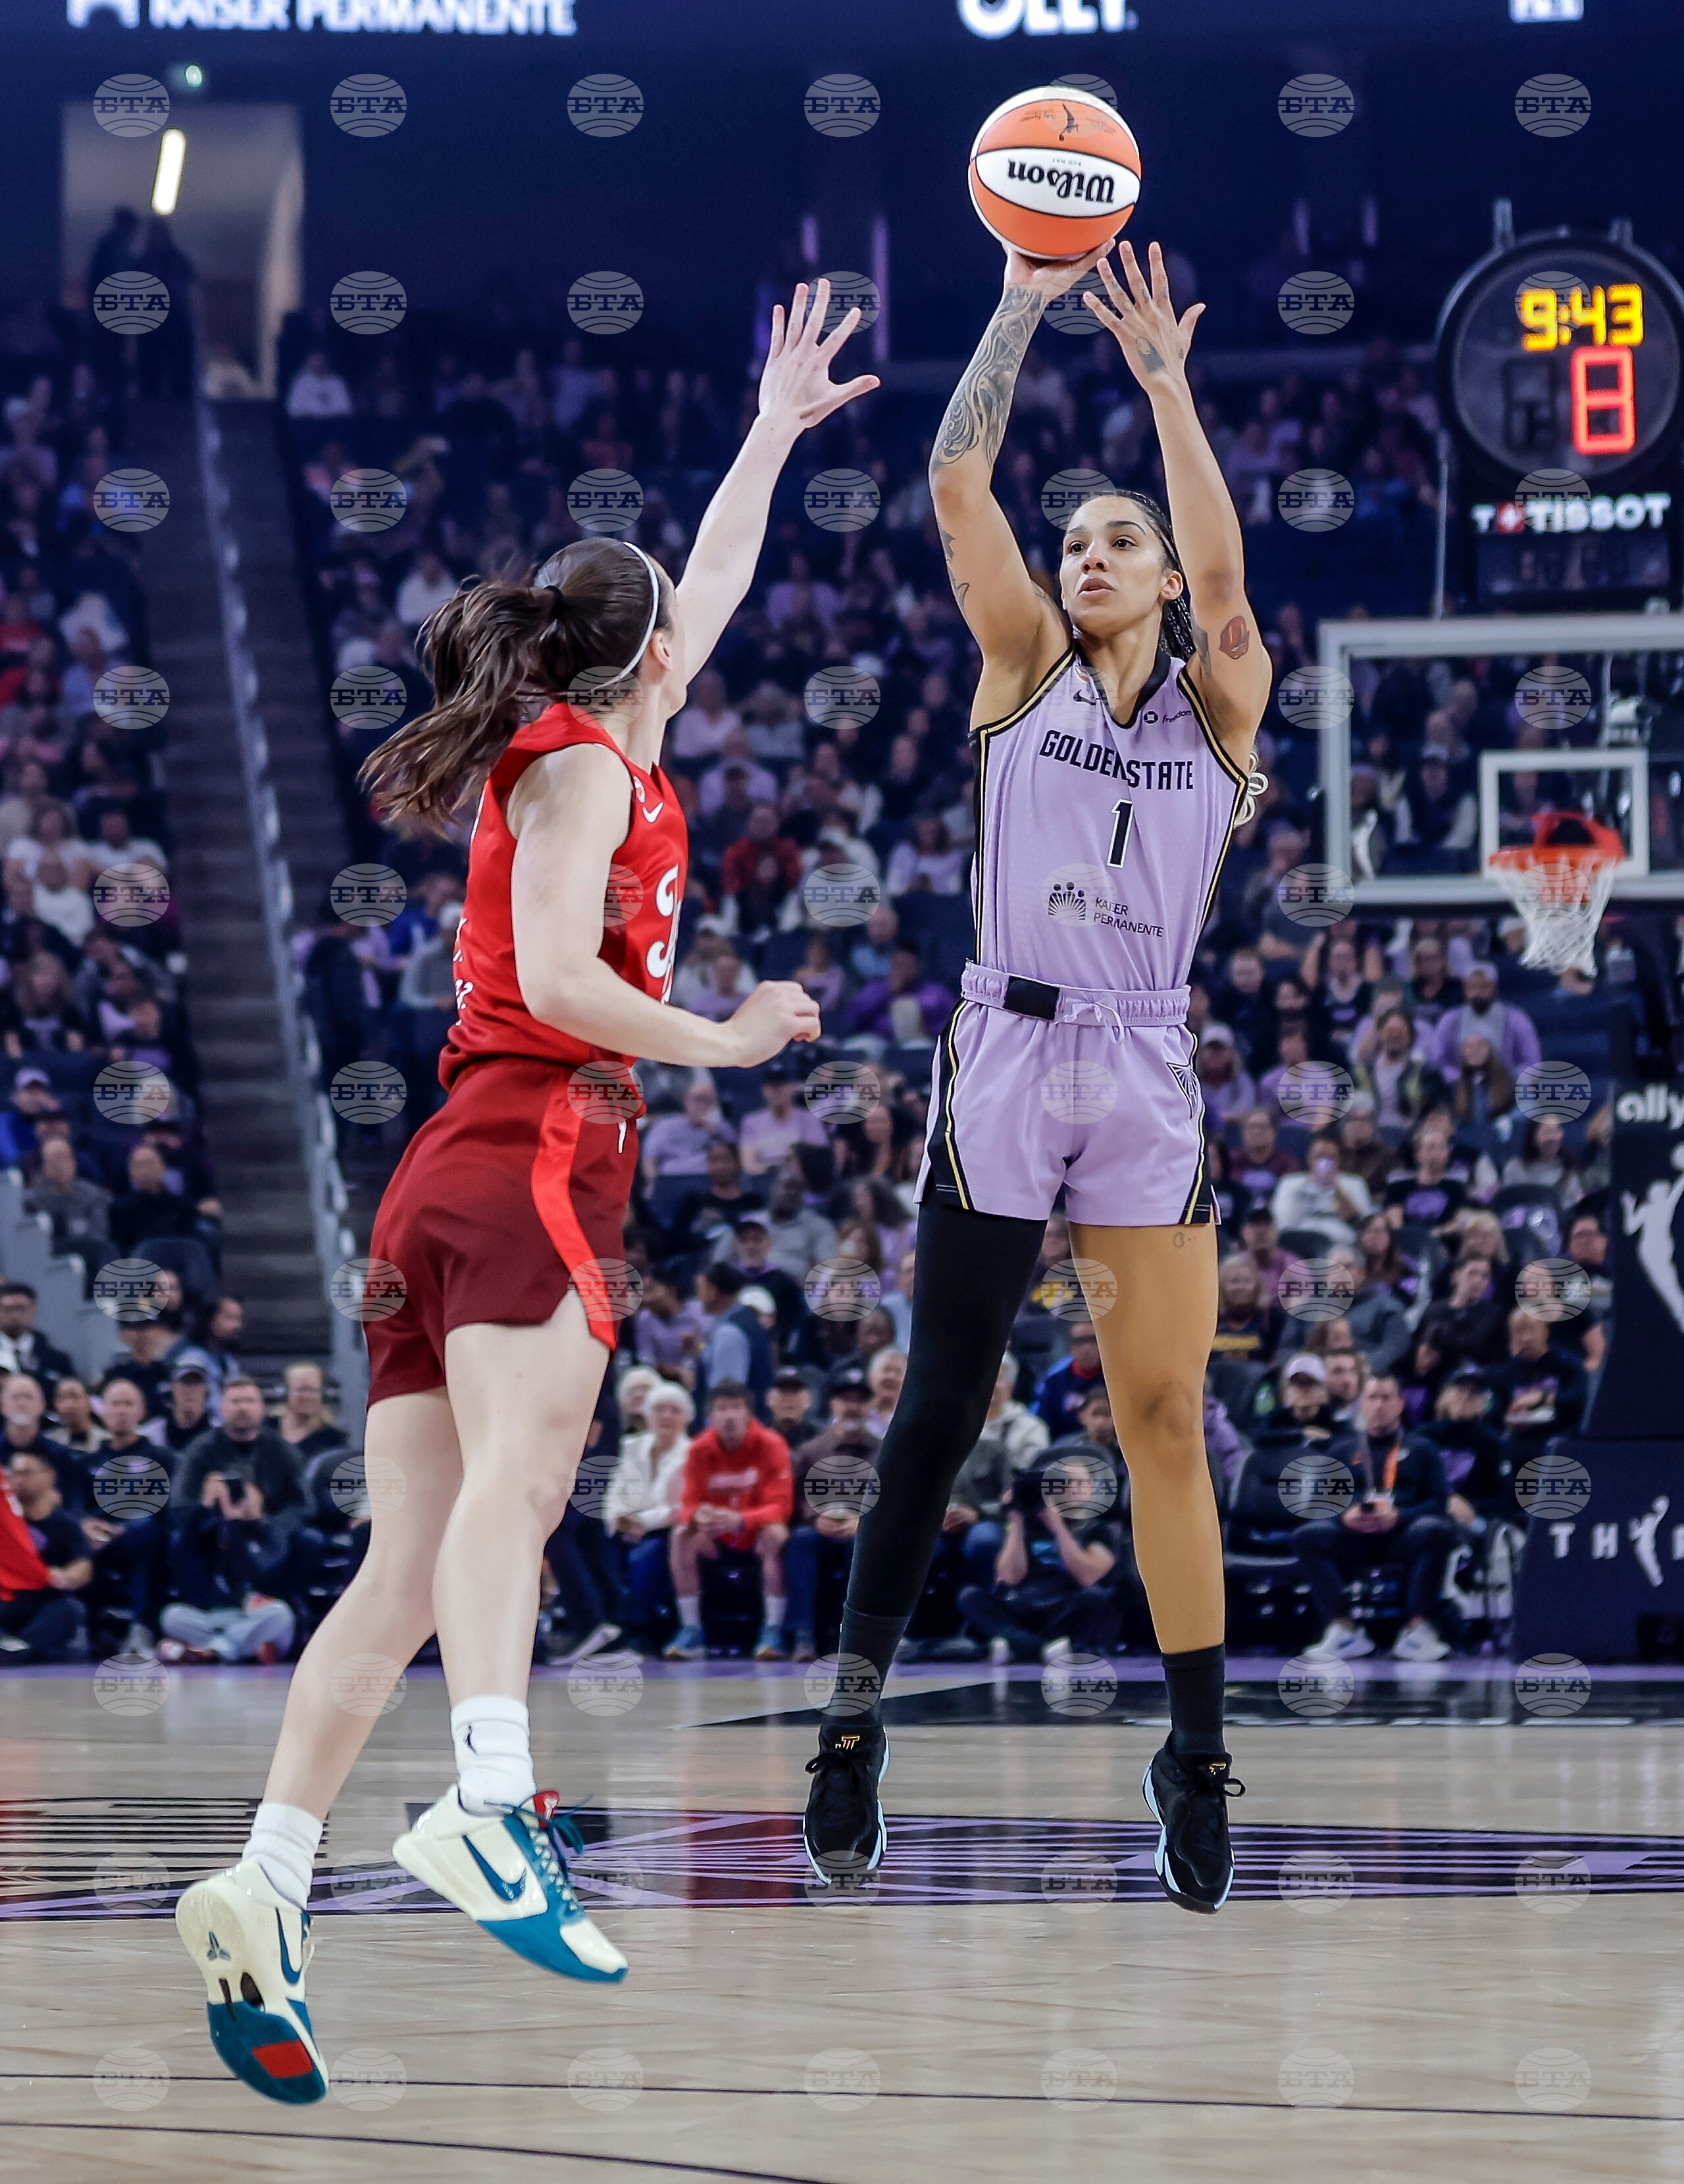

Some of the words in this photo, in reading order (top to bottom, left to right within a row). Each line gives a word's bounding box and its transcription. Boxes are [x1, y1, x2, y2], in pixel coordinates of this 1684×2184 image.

[1008, 159, 1115, 203] Wilson
[1521, 284, 1643, 351] 9:43
[1570, 345, 1636, 454] 8
[1126, 759, 1194, 790] STATE
[1106, 798, 1133, 869] 1
